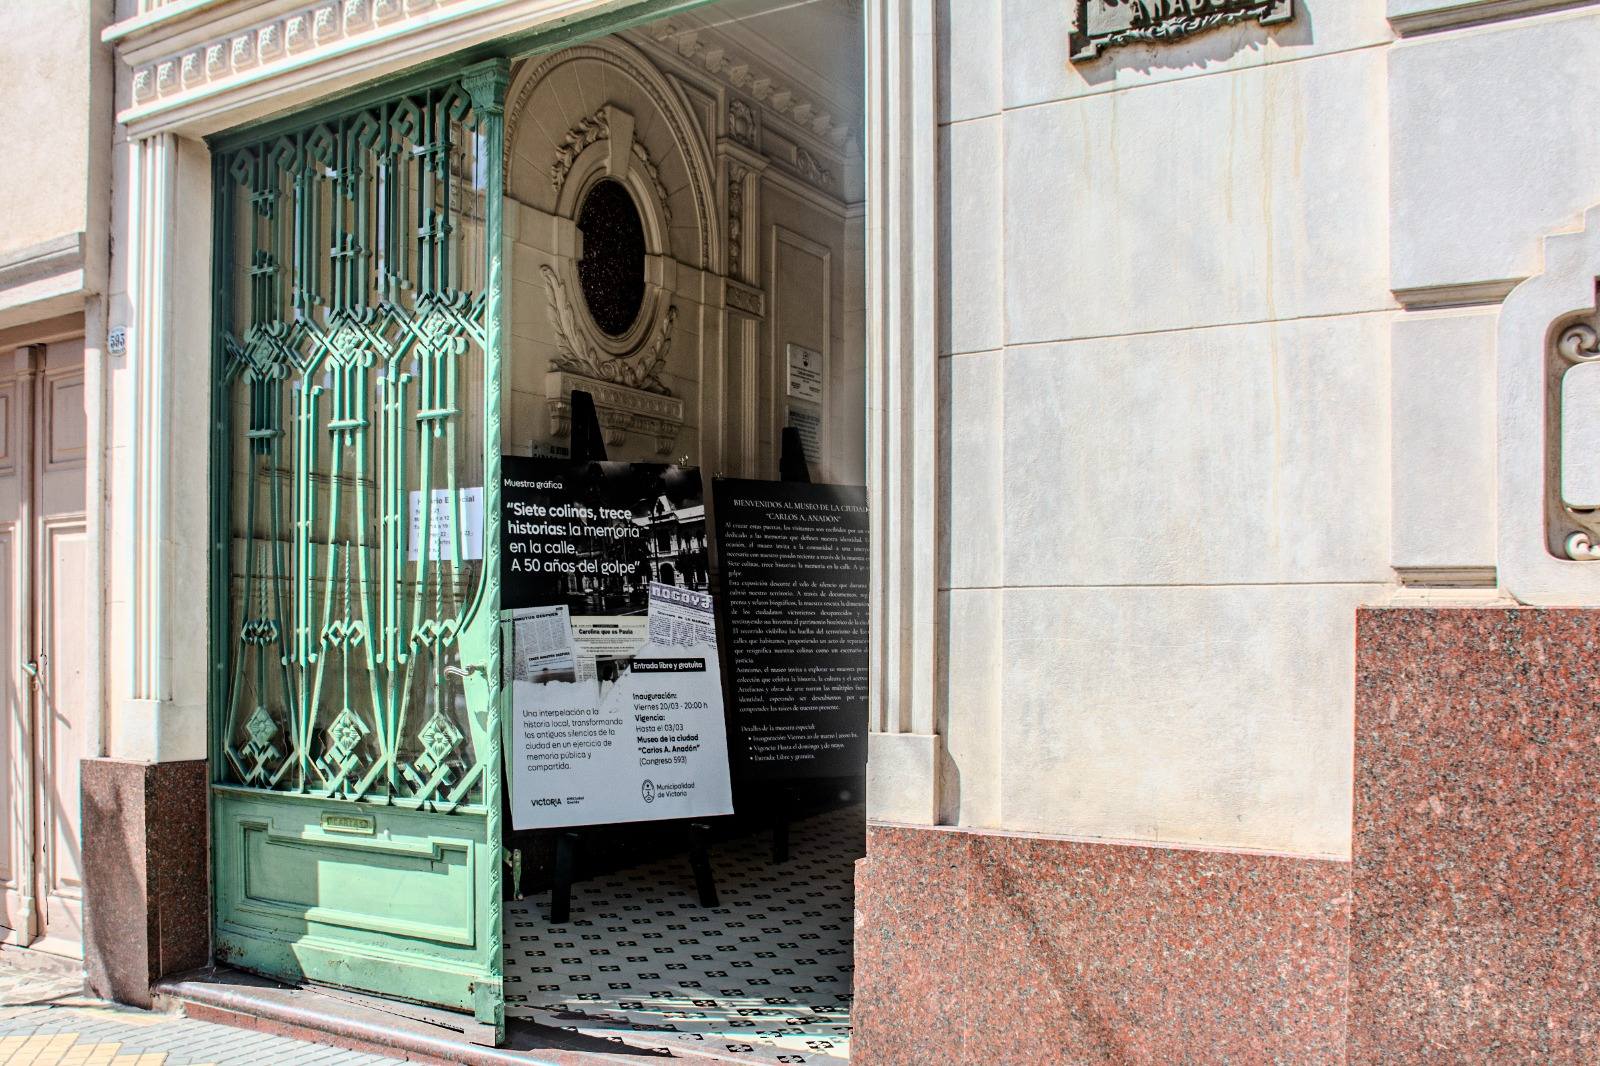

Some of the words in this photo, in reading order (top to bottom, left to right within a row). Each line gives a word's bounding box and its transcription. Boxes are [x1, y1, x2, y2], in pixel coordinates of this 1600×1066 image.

[504, 478, 535, 488] Muestra
[536, 480, 563, 490] gráfica
[734, 499, 782, 509] BIENVENIDOS
[794, 502, 819, 511] MUSEO
[831, 504, 840, 512] LA
[549, 504, 597, 520] colinas,
[599, 507, 632, 520] trece
[508, 520, 567, 536] historias:
[569, 522, 581, 536] la
[583, 525, 640, 538] memoria
[510, 542, 527, 553] en
[529, 540, 541, 553] la
[511, 558, 521, 572] A
[524, 558, 541, 572] 50
[544, 559, 576, 573] años
[578, 559, 598, 573] del
[659, 661, 673, 669] libre
[678, 661, 703, 670] gratuita
[633, 692, 677, 701] Inauguración:
[634, 703, 659, 711] Viernes
[660, 702, 679, 711] 20/03
[684, 701, 702, 710] 20:00
[703, 701, 709, 709] h
[523, 709, 538, 718] Una
[540, 709, 585, 718] interpelación
[592, 707, 599, 716] la
[524, 720, 551, 728] historia
[552, 719, 570, 728] local,
[572, 718, 623, 727] transformando
[635, 714, 666, 722] Vigencia:
[537, 730, 567, 740] antiguos
[568, 729, 597, 738] silencios
[598, 729, 607, 737] de
[637, 735, 659, 743] Museo
[669, 734, 676, 742] la
[677, 733, 699, 742] ciudad
[526, 741, 551, 750] ciudad
[573, 740, 602, 749] ejercicio
[664, 745, 671, 753] A.
[527, 752, 559, 761] memoria
[560, 751, 586, 760] pública
[587, 752, 592, 760] y
[640, 757, 672, 766] (Congreso
[656, 781, 695, 791] Municipalidad
[666, 790, 688, 798] Victoria
[531, 798, 562, 807] VICTORIA
